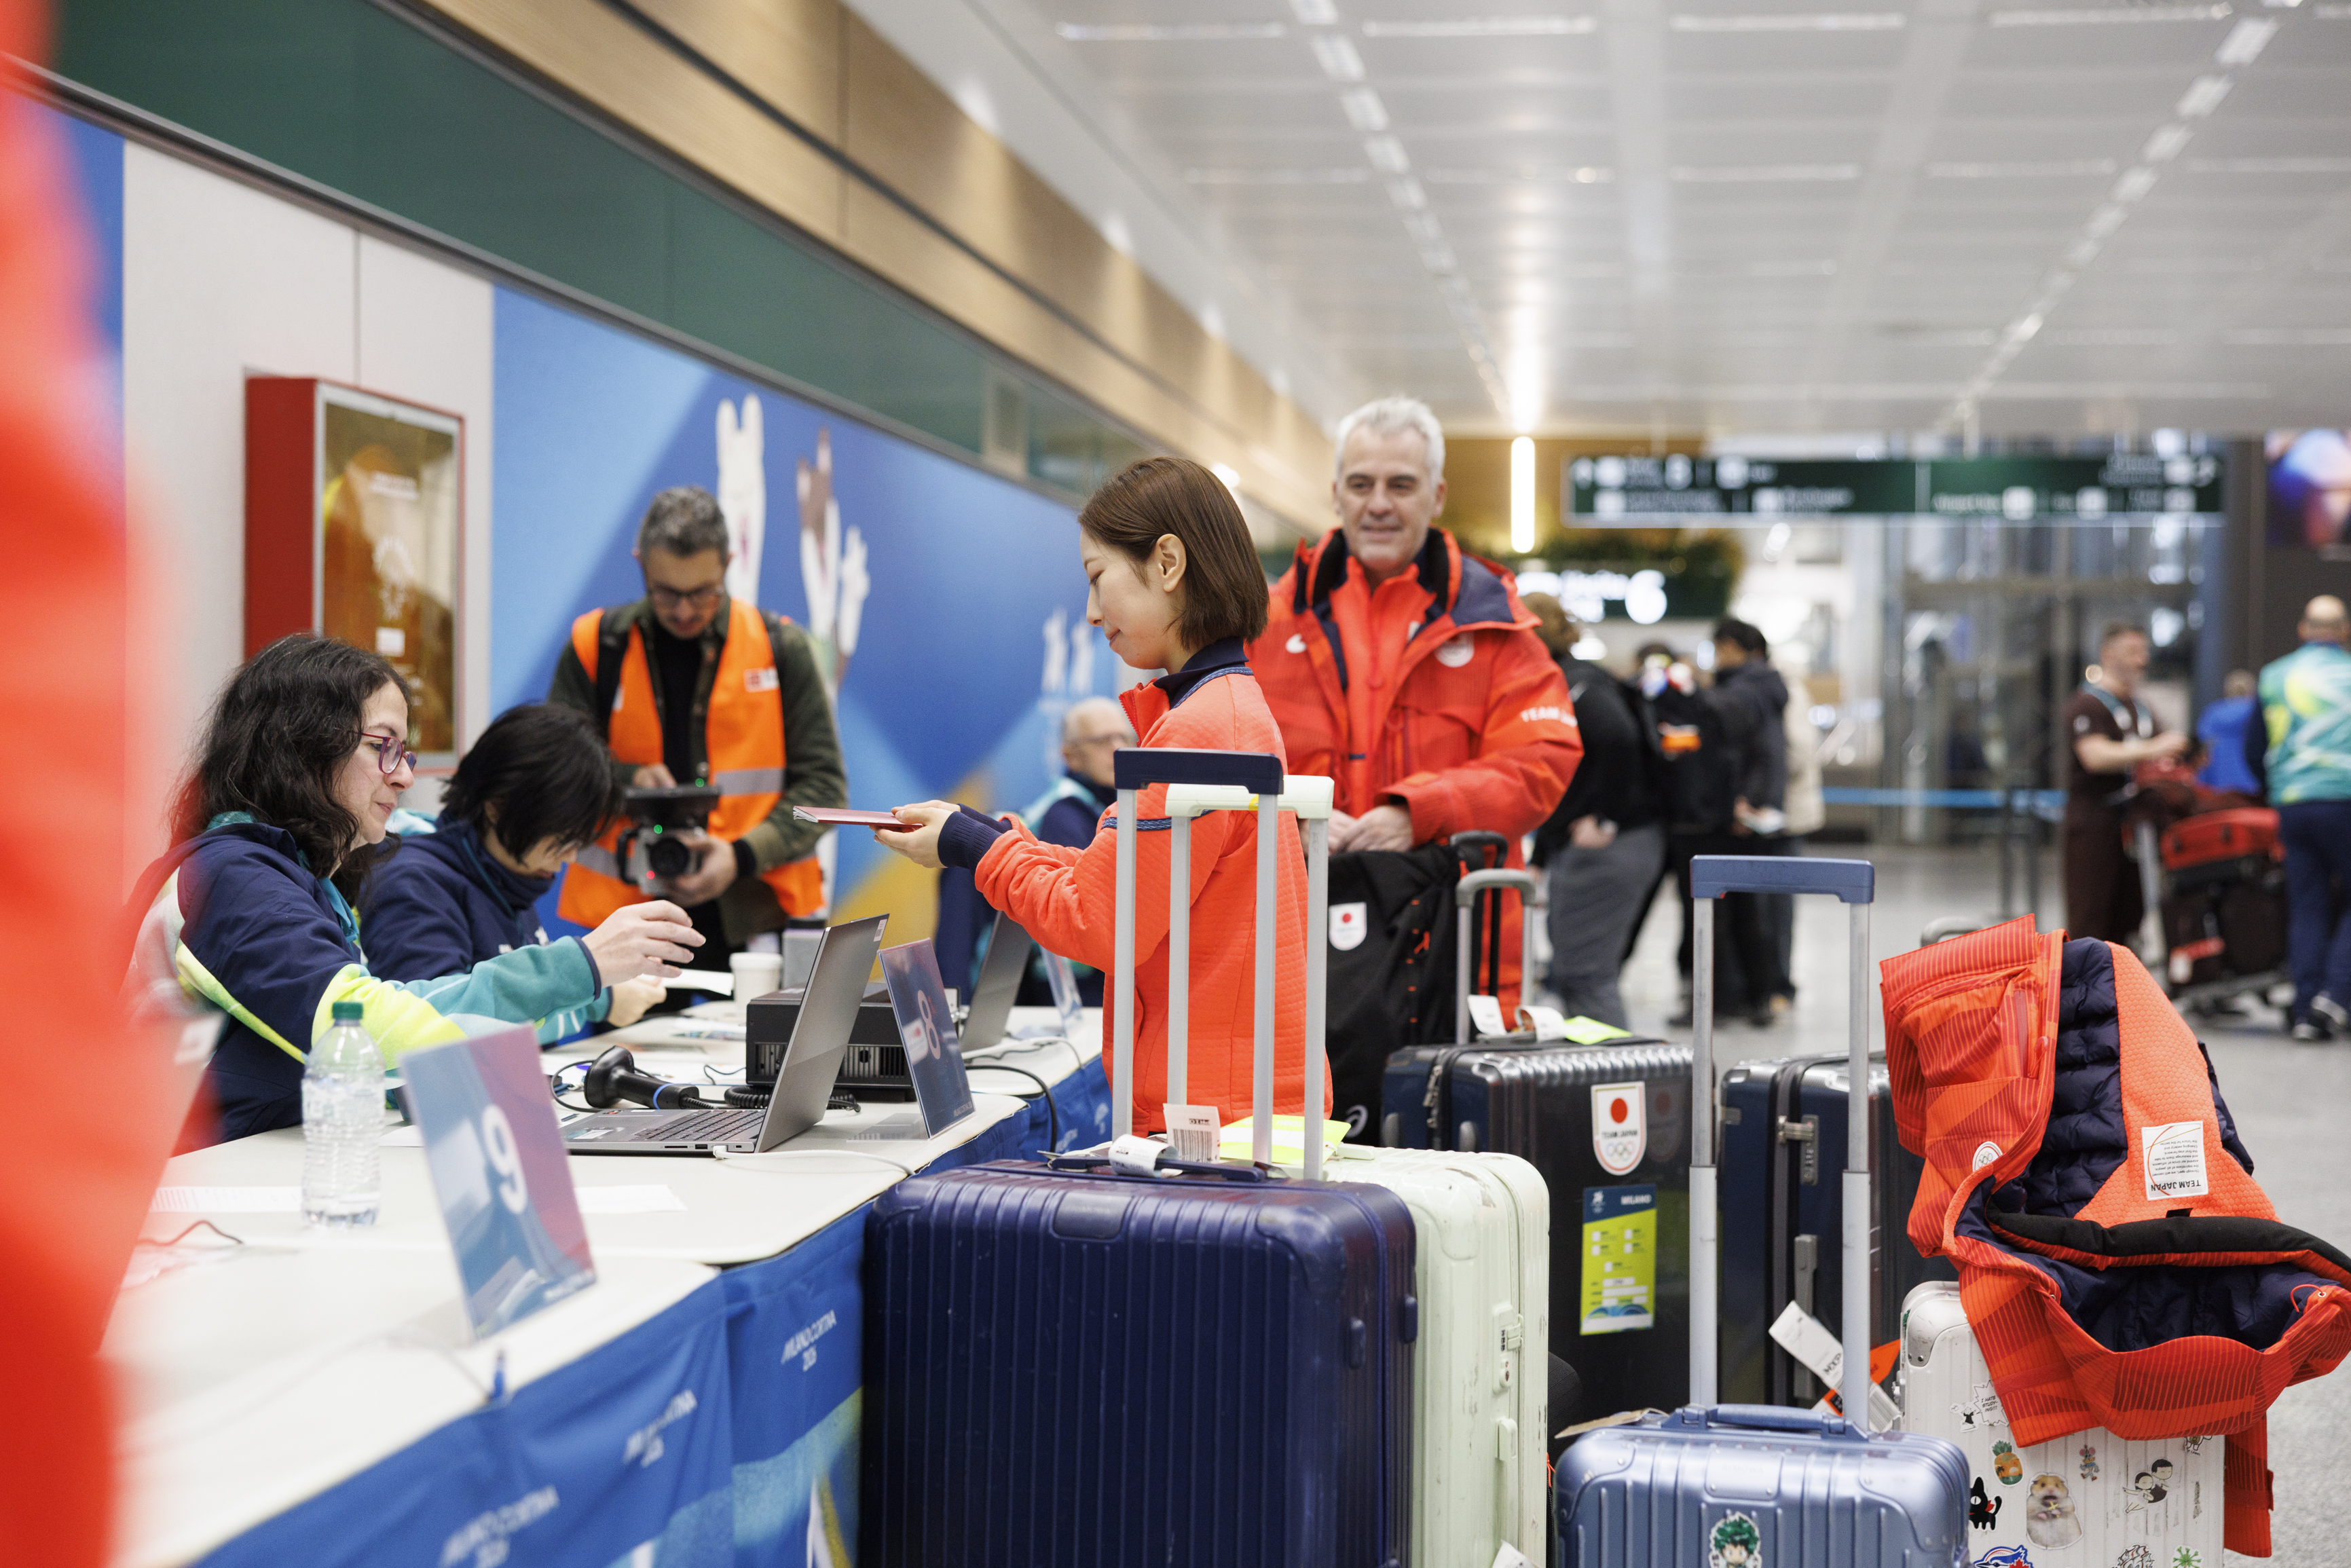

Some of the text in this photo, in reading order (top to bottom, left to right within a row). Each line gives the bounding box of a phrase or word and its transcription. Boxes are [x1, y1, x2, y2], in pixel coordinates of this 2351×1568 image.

[1520, 707, 1559, 722] TEAM
[917, 990, 940, 1060] 8
[482, 1104, 527, 1215] 9
[2151, 1180, 2200, 1191] TEAM JAPAN
[1621, 1194, 1652, 1206] MILANO
[1823, 1353, 1842, 1375] MXP
